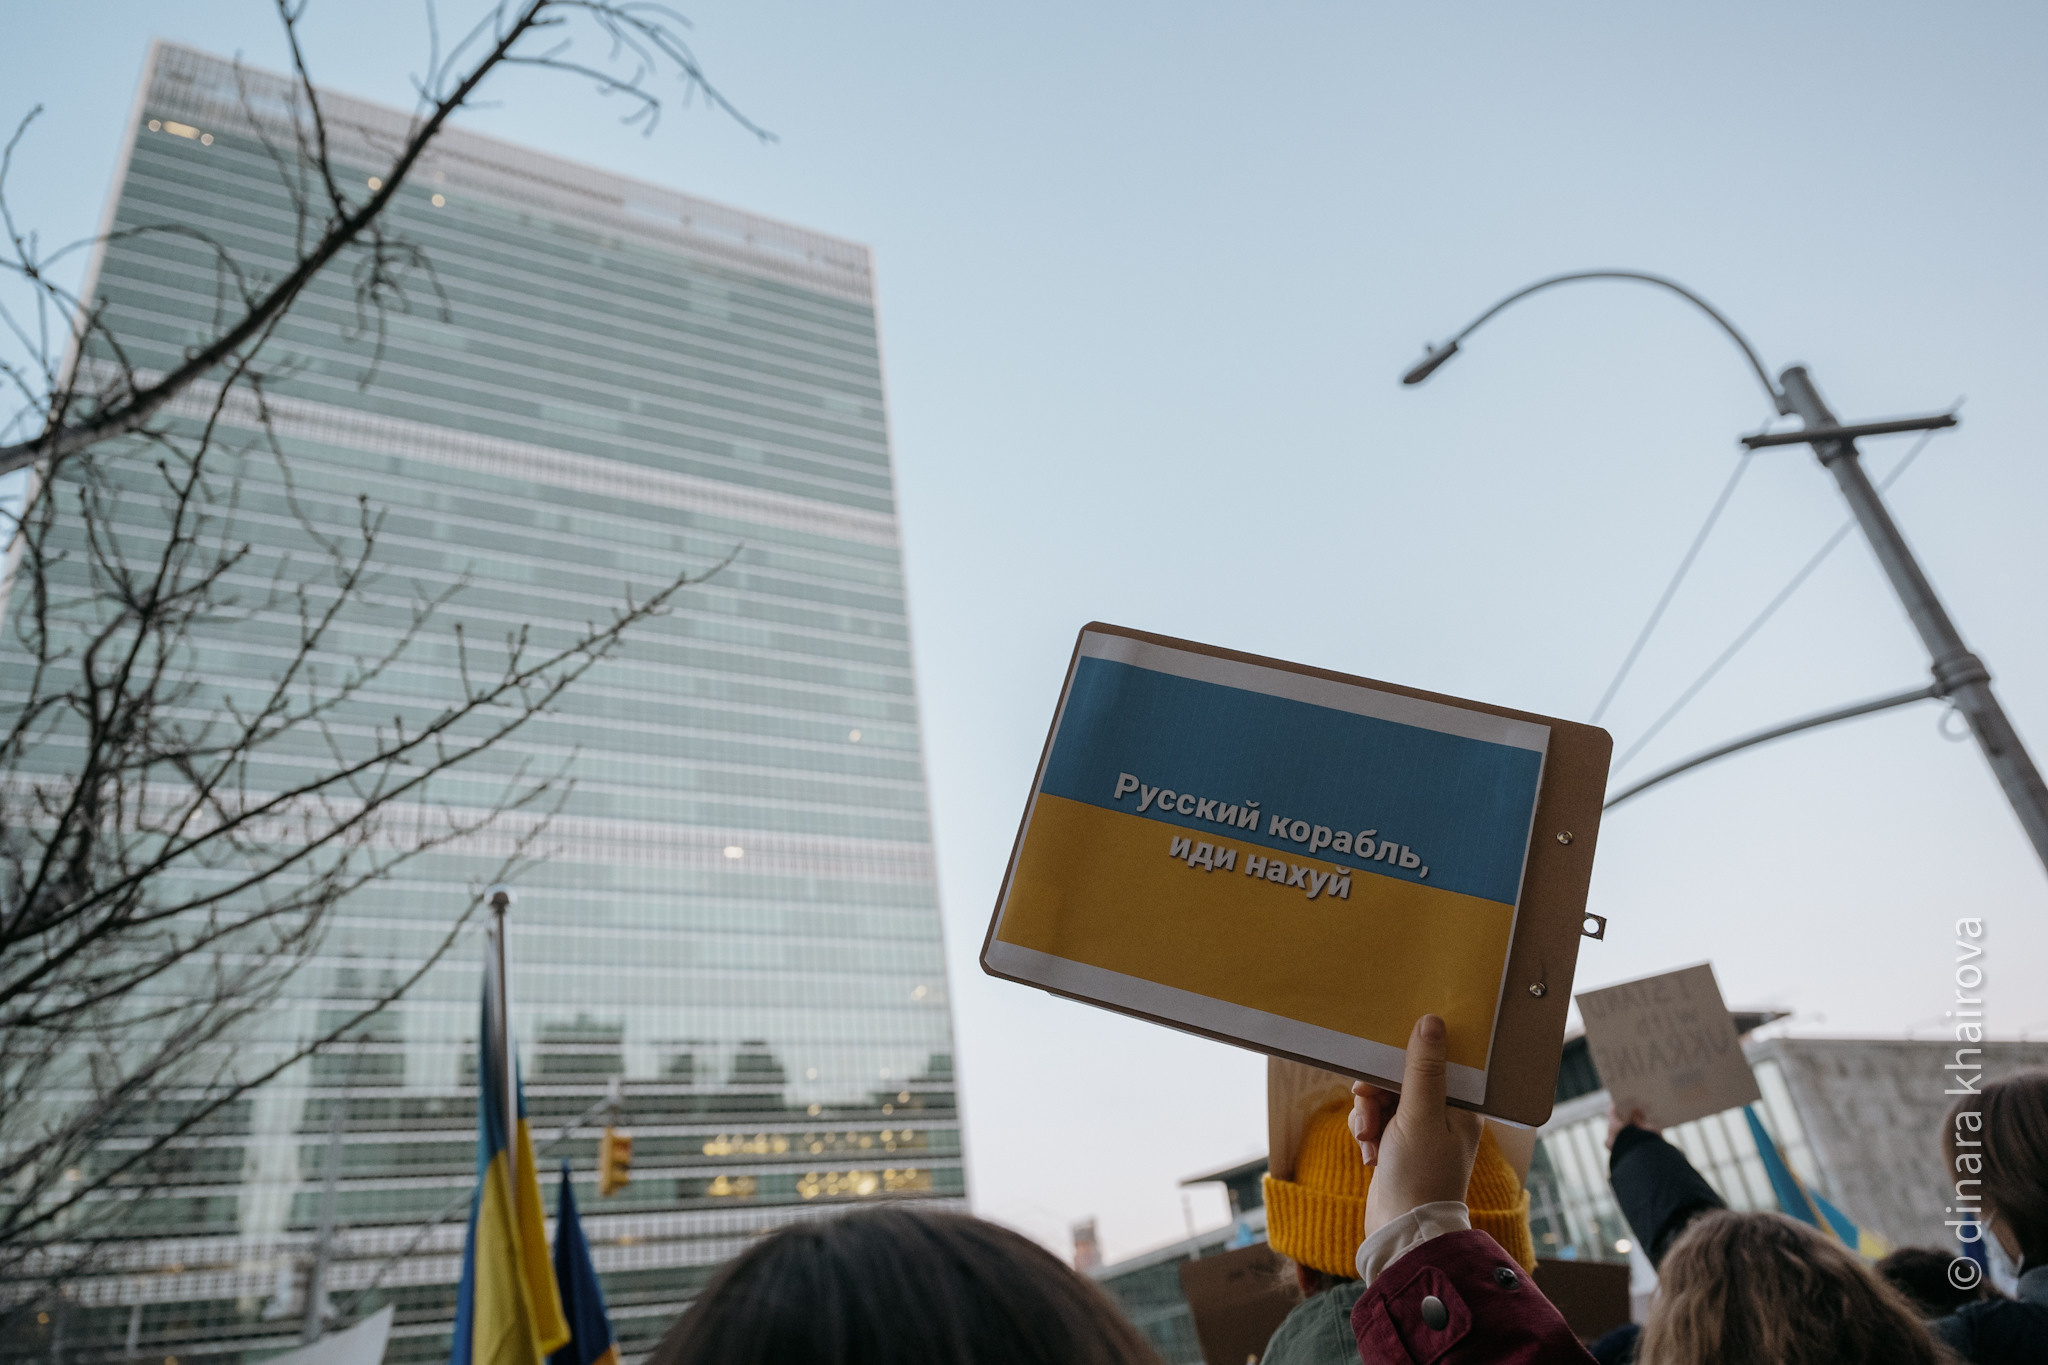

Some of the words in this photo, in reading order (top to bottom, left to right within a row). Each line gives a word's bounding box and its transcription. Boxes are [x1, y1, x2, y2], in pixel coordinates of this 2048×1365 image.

[1114, 772, 1261, 831] Русский
[1269, 814, 1430, 878] корабль,
[1169, 836, 1238, 871] иди
[1245, 853, 1352, 899] нахуй
